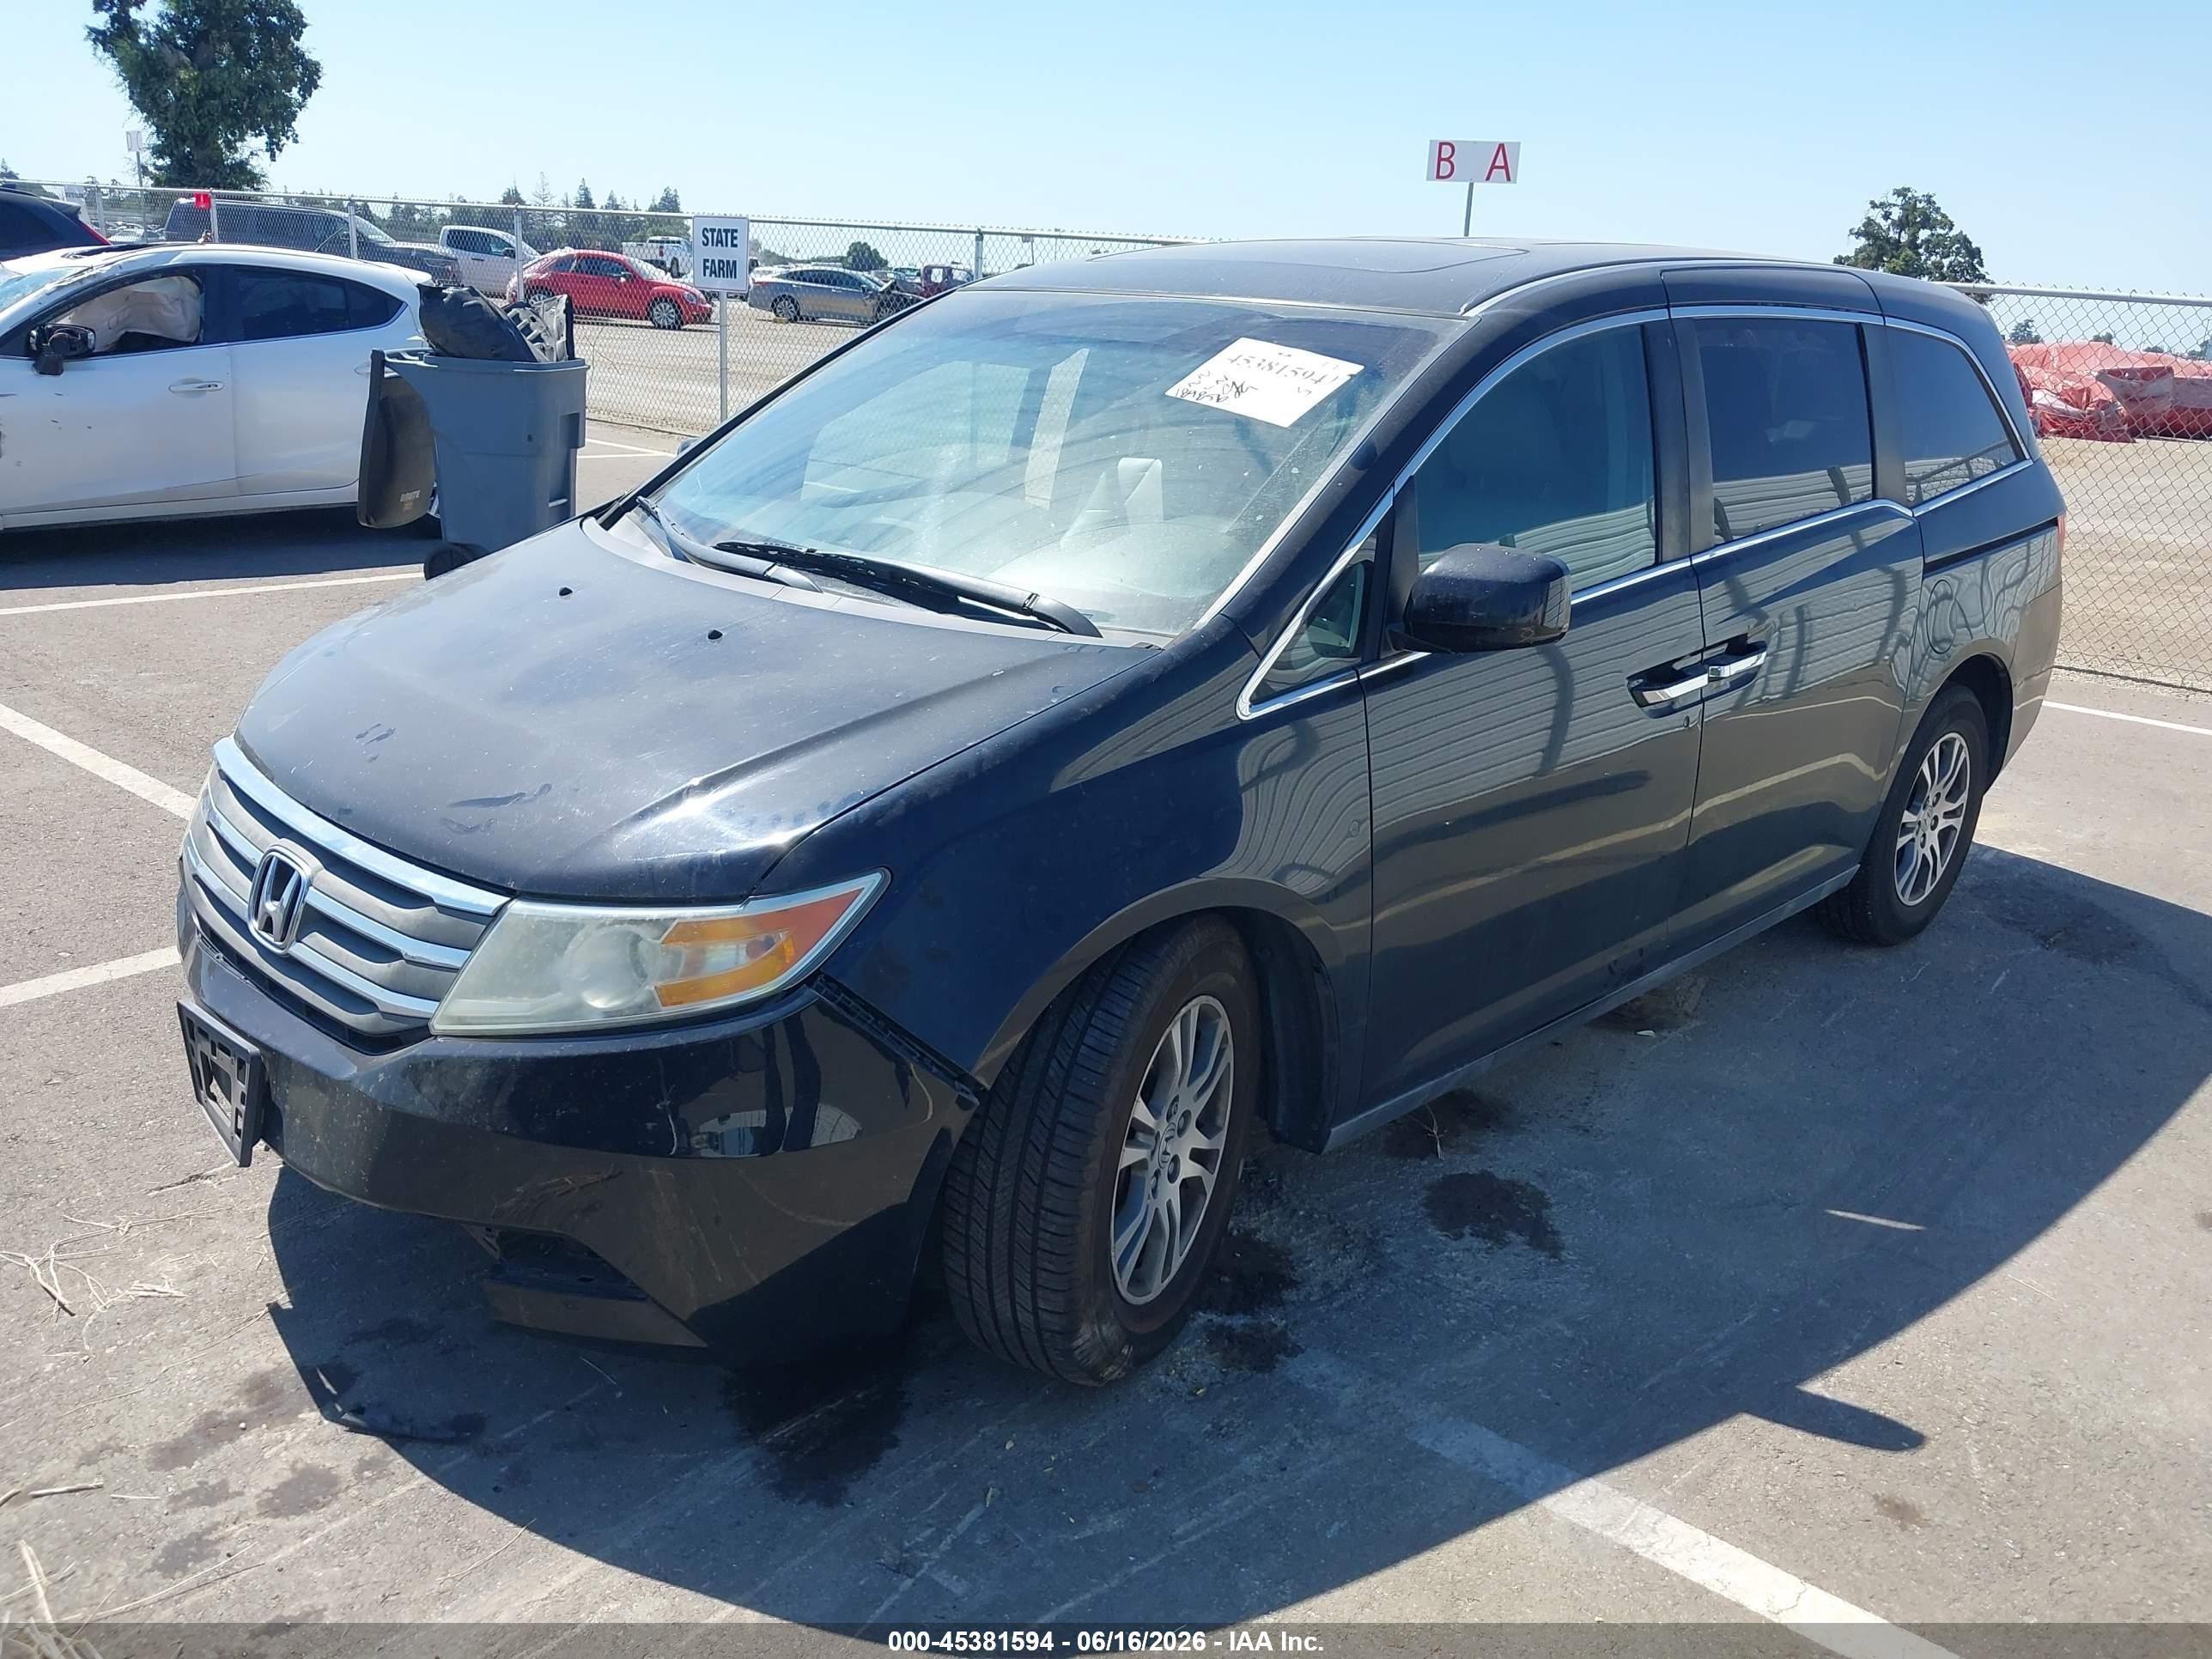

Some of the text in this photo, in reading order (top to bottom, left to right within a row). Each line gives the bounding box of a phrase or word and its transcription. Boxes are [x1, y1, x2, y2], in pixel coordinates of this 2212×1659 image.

[1435, 142, 1511, 182] B A
[702, 227, 738, 248] STATE
[702, 258, 738, 279] FARM
